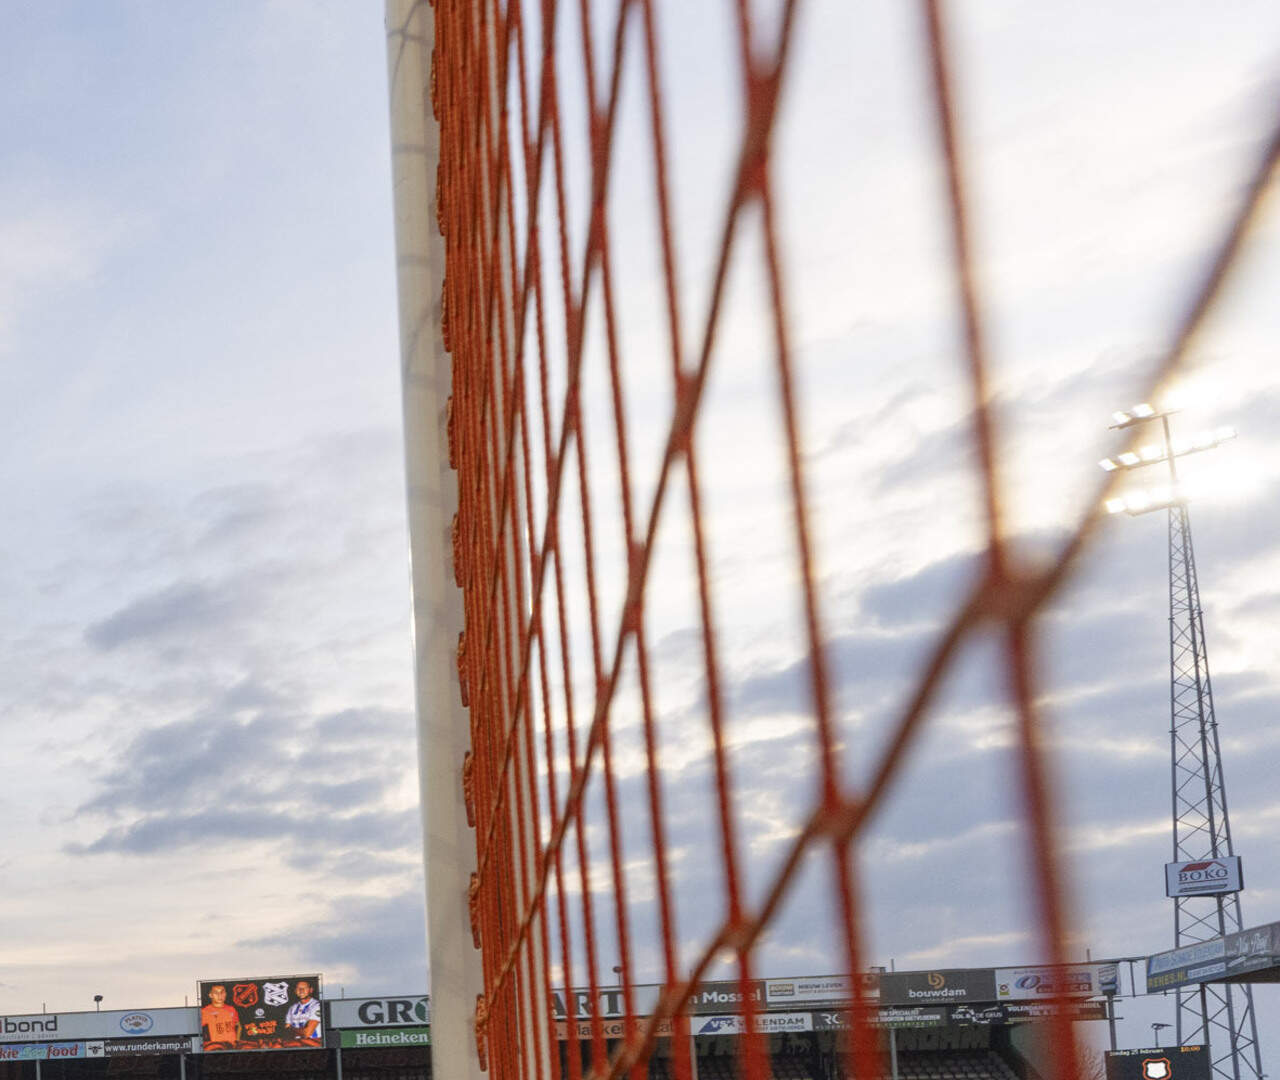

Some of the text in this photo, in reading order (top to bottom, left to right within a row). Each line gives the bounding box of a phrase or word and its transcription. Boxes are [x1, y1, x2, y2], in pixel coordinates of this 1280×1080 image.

[1179, 869, 1228, 882] BOKO
[909, 988, 967, 999] bouwdam
[5, 1016, 57, 1033] bond
[356, 1032, 429, 1047] Heineken
[105, 1041, 192, 1052] www.runderkamp.nl
